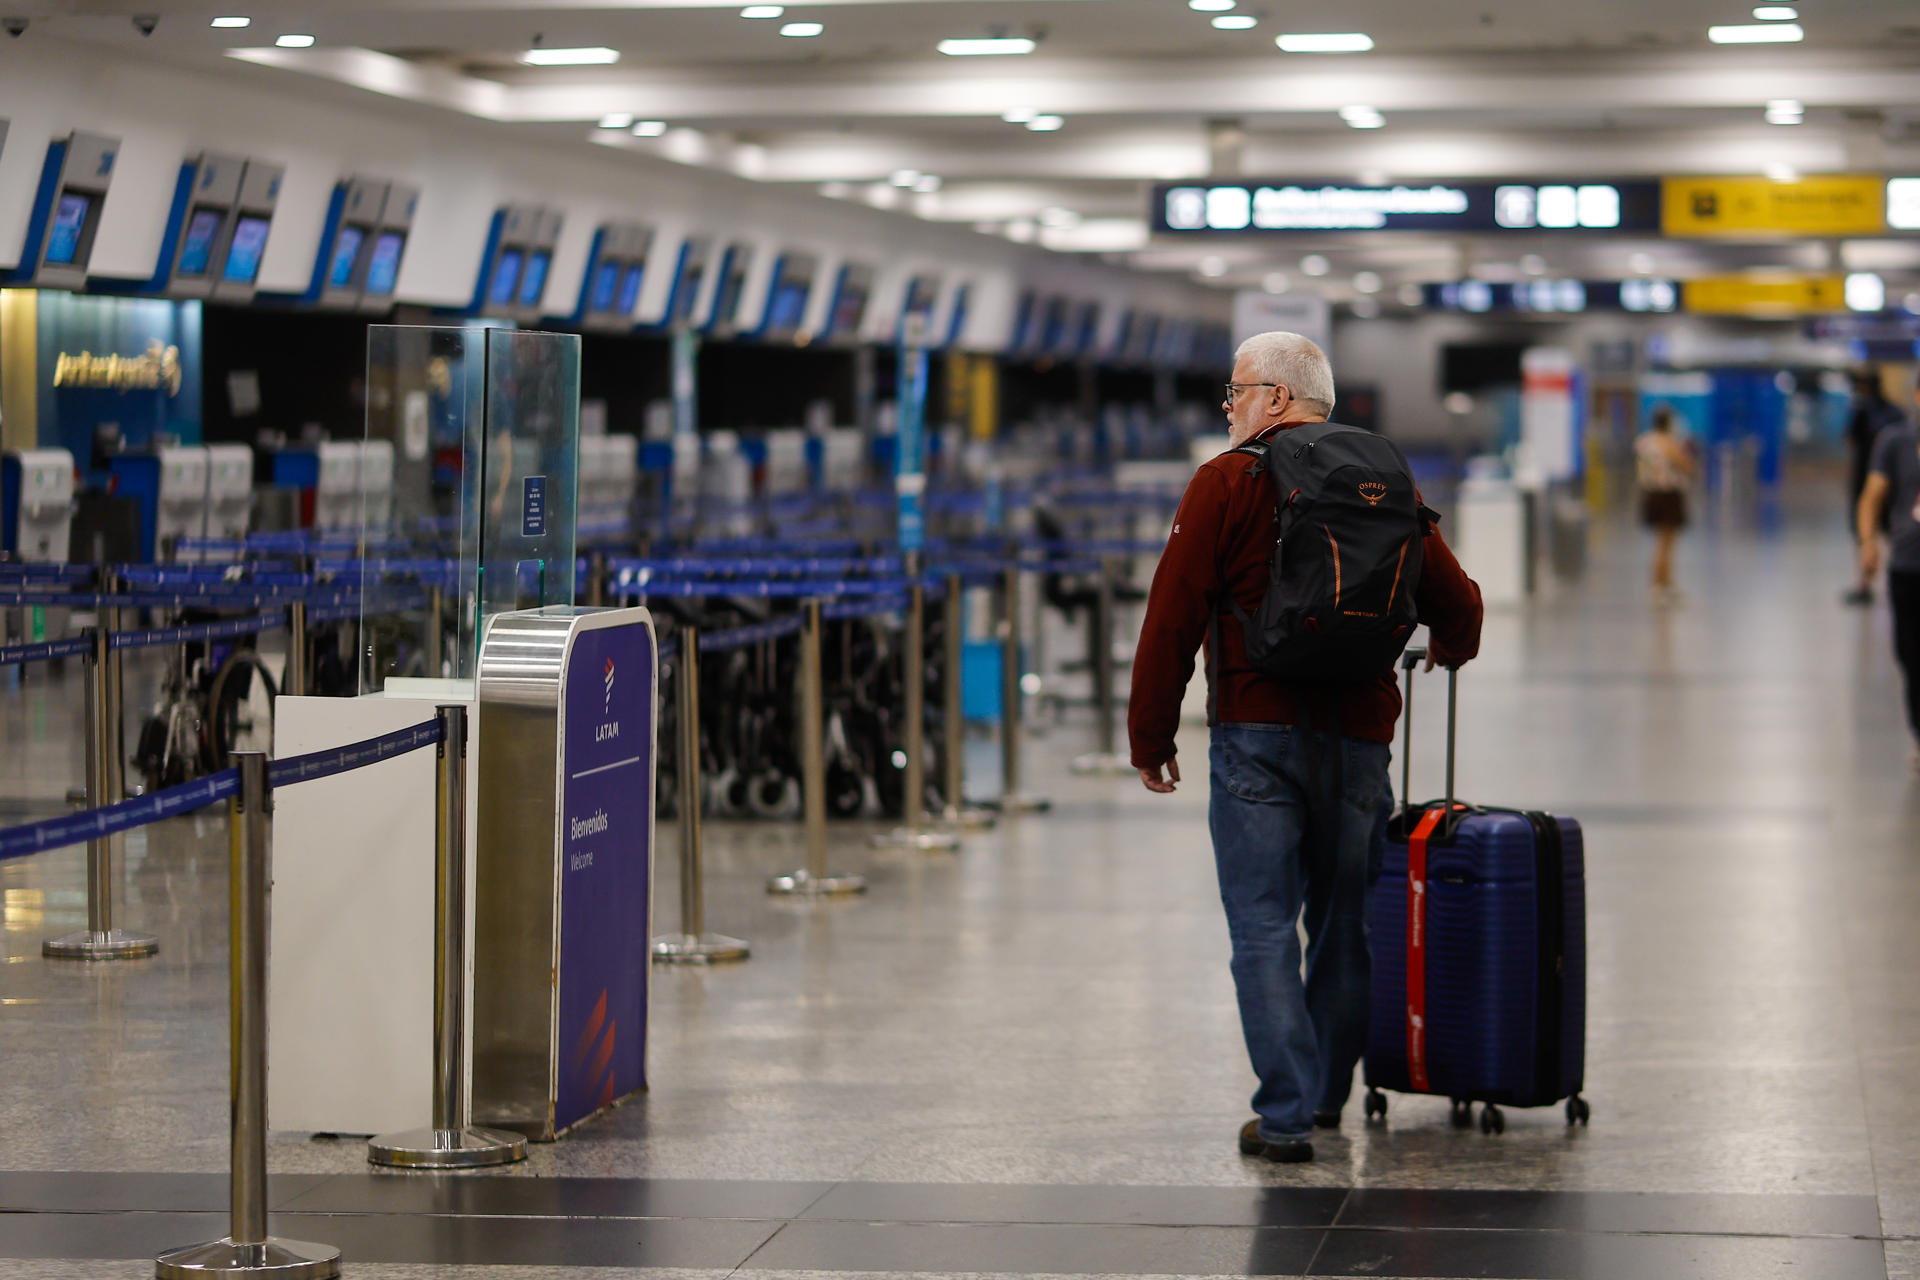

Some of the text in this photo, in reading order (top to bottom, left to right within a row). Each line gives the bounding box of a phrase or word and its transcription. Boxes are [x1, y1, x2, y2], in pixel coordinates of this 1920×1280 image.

[1359, 482, 1386, 491] OSPREY
[595, 721, 619, 742] LATAM
[571, 807, 608, 841] Bienvenidos
[570, 850, 593, 872] Welcome
